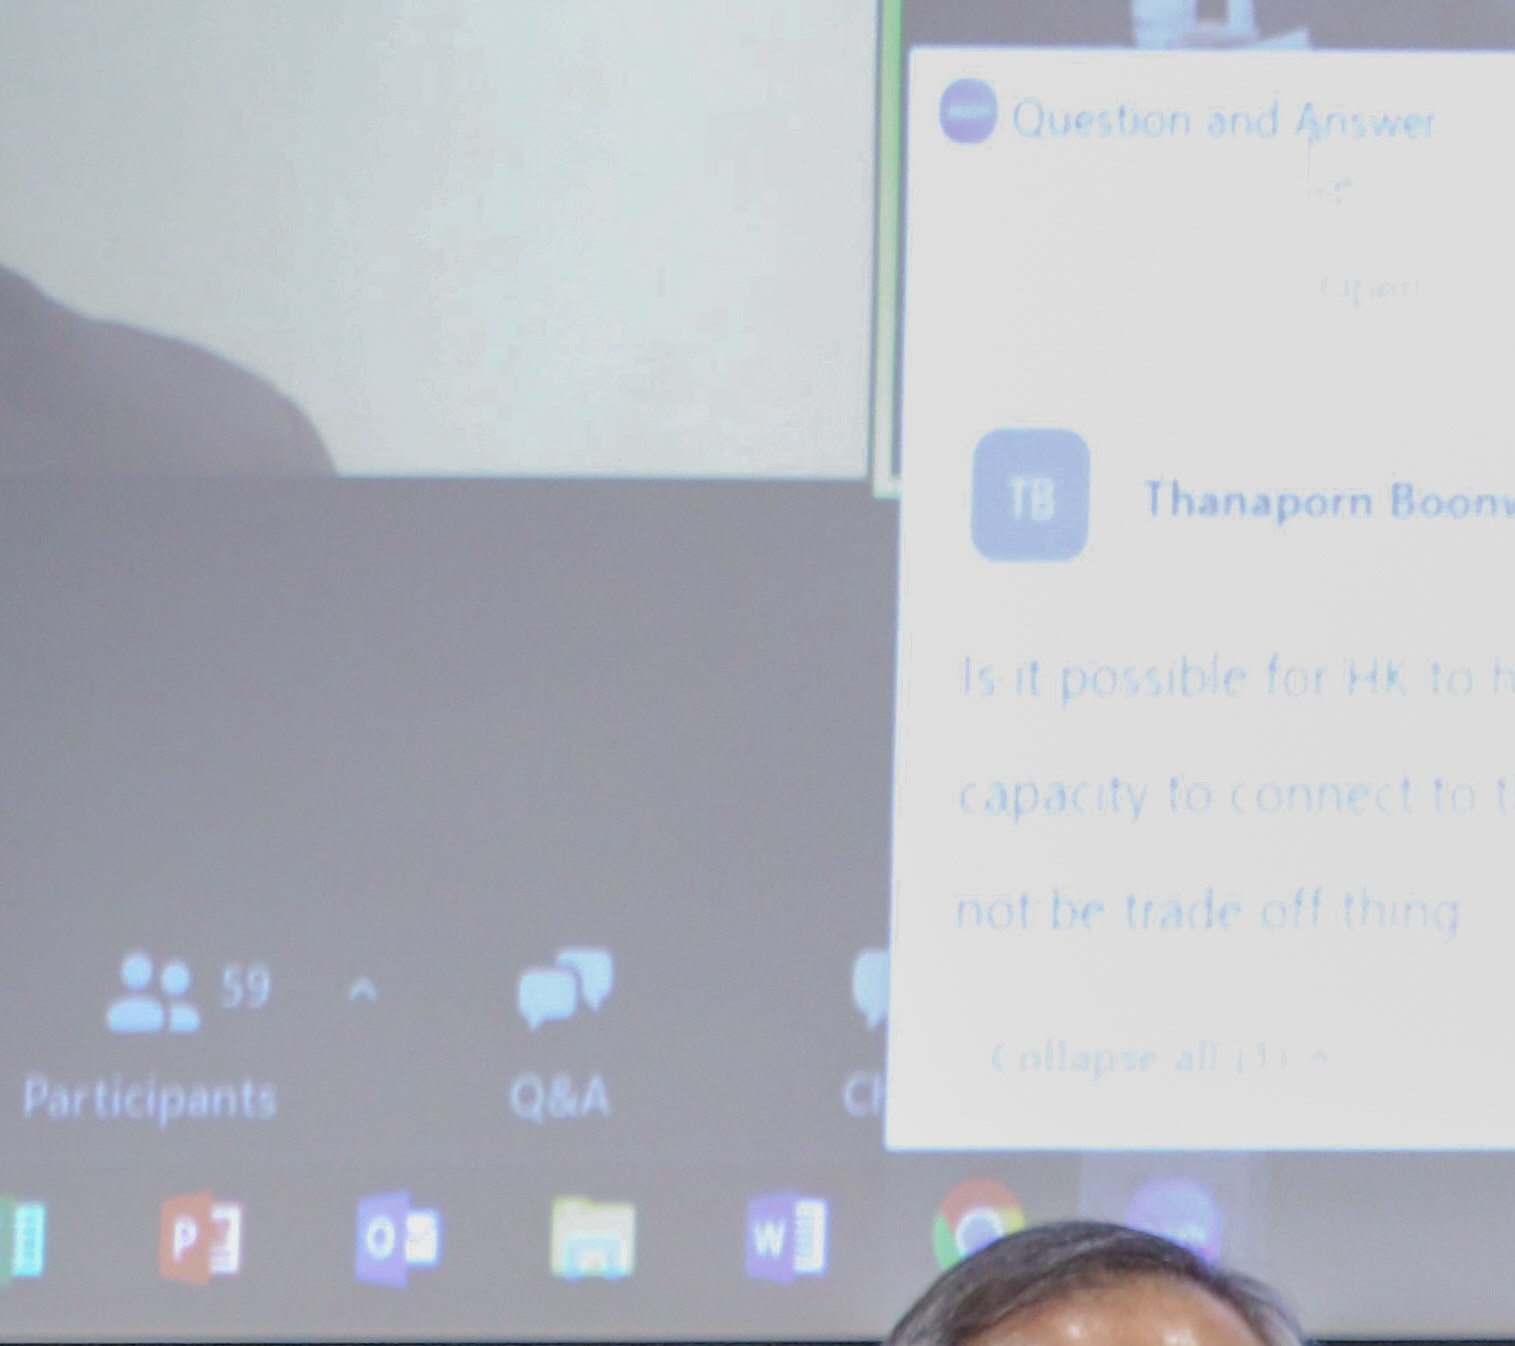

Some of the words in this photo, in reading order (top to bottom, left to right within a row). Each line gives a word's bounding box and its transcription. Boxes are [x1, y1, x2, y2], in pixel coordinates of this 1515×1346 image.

[1012, 97, 1191, 140] Question
[1206, 99, 1280, 139] and
[1295, 101, 1435, 140] Answer
[1008, 475, 1056, 521] TB
[1144, 479, 1374, 528] Thanaporn
[962, 656, 997, 697] Is
[1015, 656, 1041, 697] it
[1060, 654, 1248, 709] possible
[1265, 651, 1327, 697] for
[1346, 656, 1408, 697] HK
[1430, 658, 1475, 697] to
[958, 775, 1149, 826] capacity
[1167, 775, 1213, 814] to
[1230, 775, 1413, 816] connect
[1432, 776, 1478, 815] to
[956, 889, 1032, 930] not
[1050, 887, 1106, 931] be
[1125, 887, 1243, 931] trade
[1260, 887, 1323, 929] off
[1342, 888, 1460, 941] thing
[221, 965, 270, 1008] 59
[24, 1073, 277, 1129] Participants
[509, 1072, 612, 1122] Q&A
